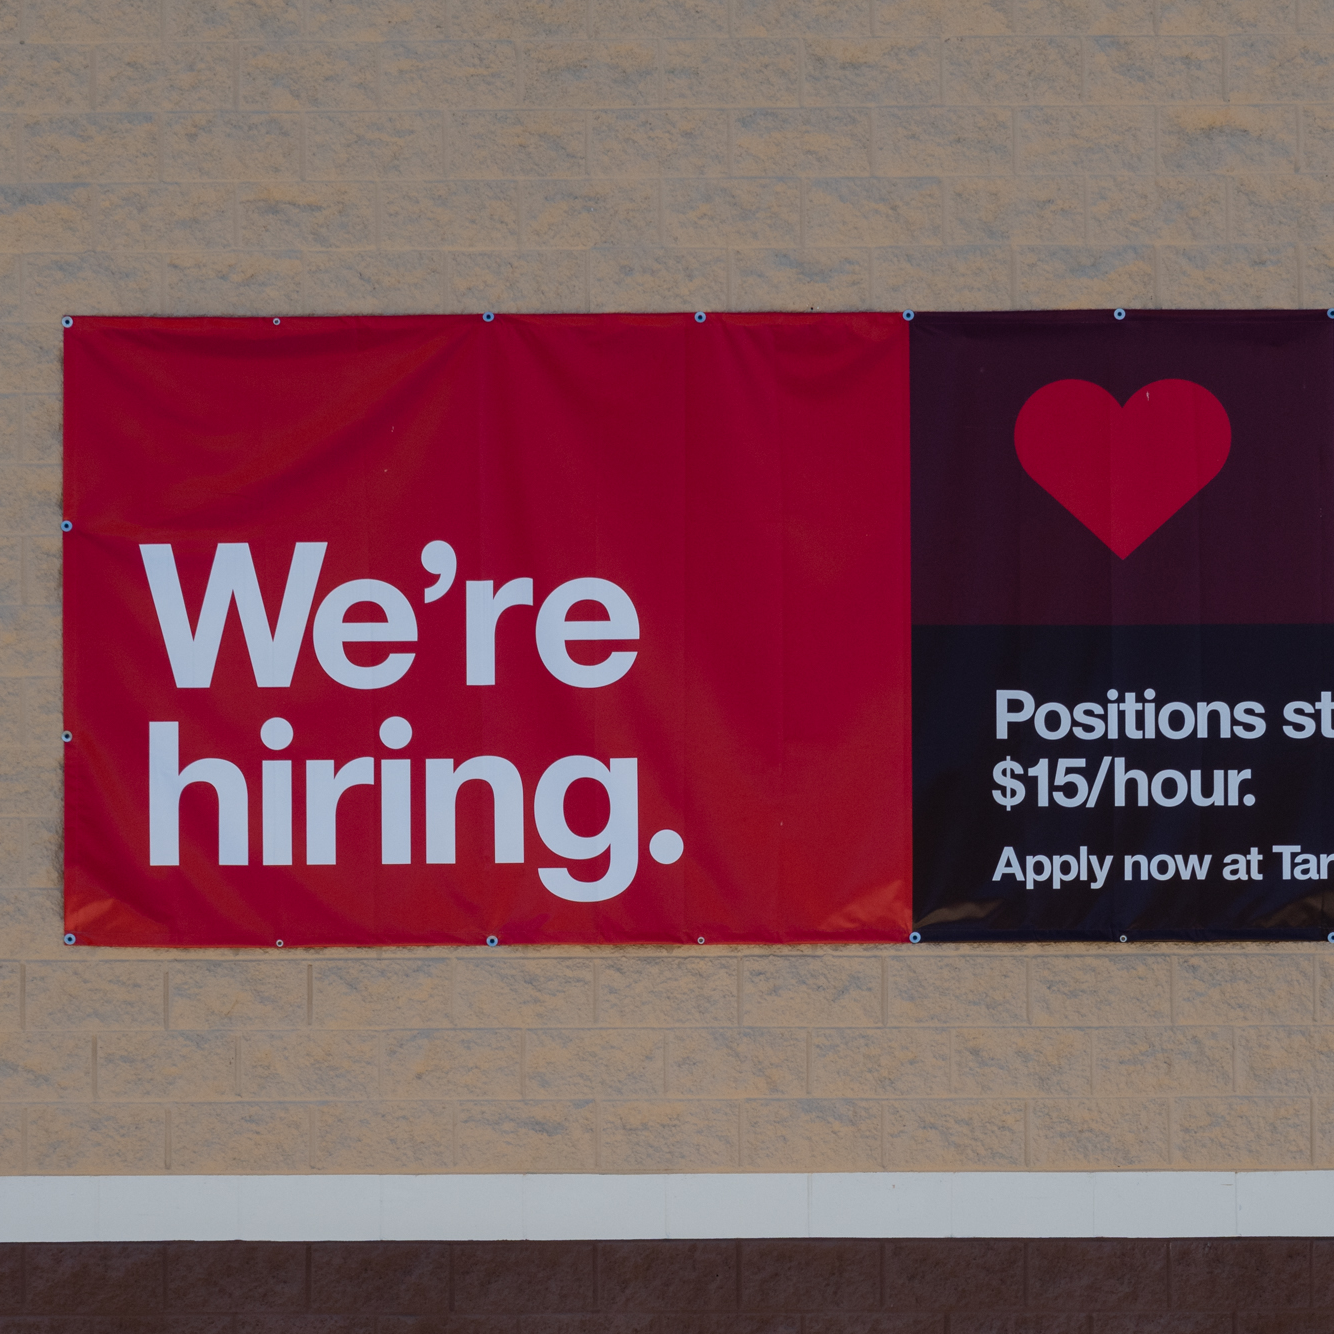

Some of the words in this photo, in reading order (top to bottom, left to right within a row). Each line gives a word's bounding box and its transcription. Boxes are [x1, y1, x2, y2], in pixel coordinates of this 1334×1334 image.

[139, 540, 640, 690] We’re
[996, 688, 1267, 740] Positions
[148, 716, 684, 903] hiring.
[991, 755, 1256, 812] $15/hour.
[991, 845, 1114, 890] Apply
[1124, 854, 1213, 881] now
[1222, 847, 1263, 881] at
